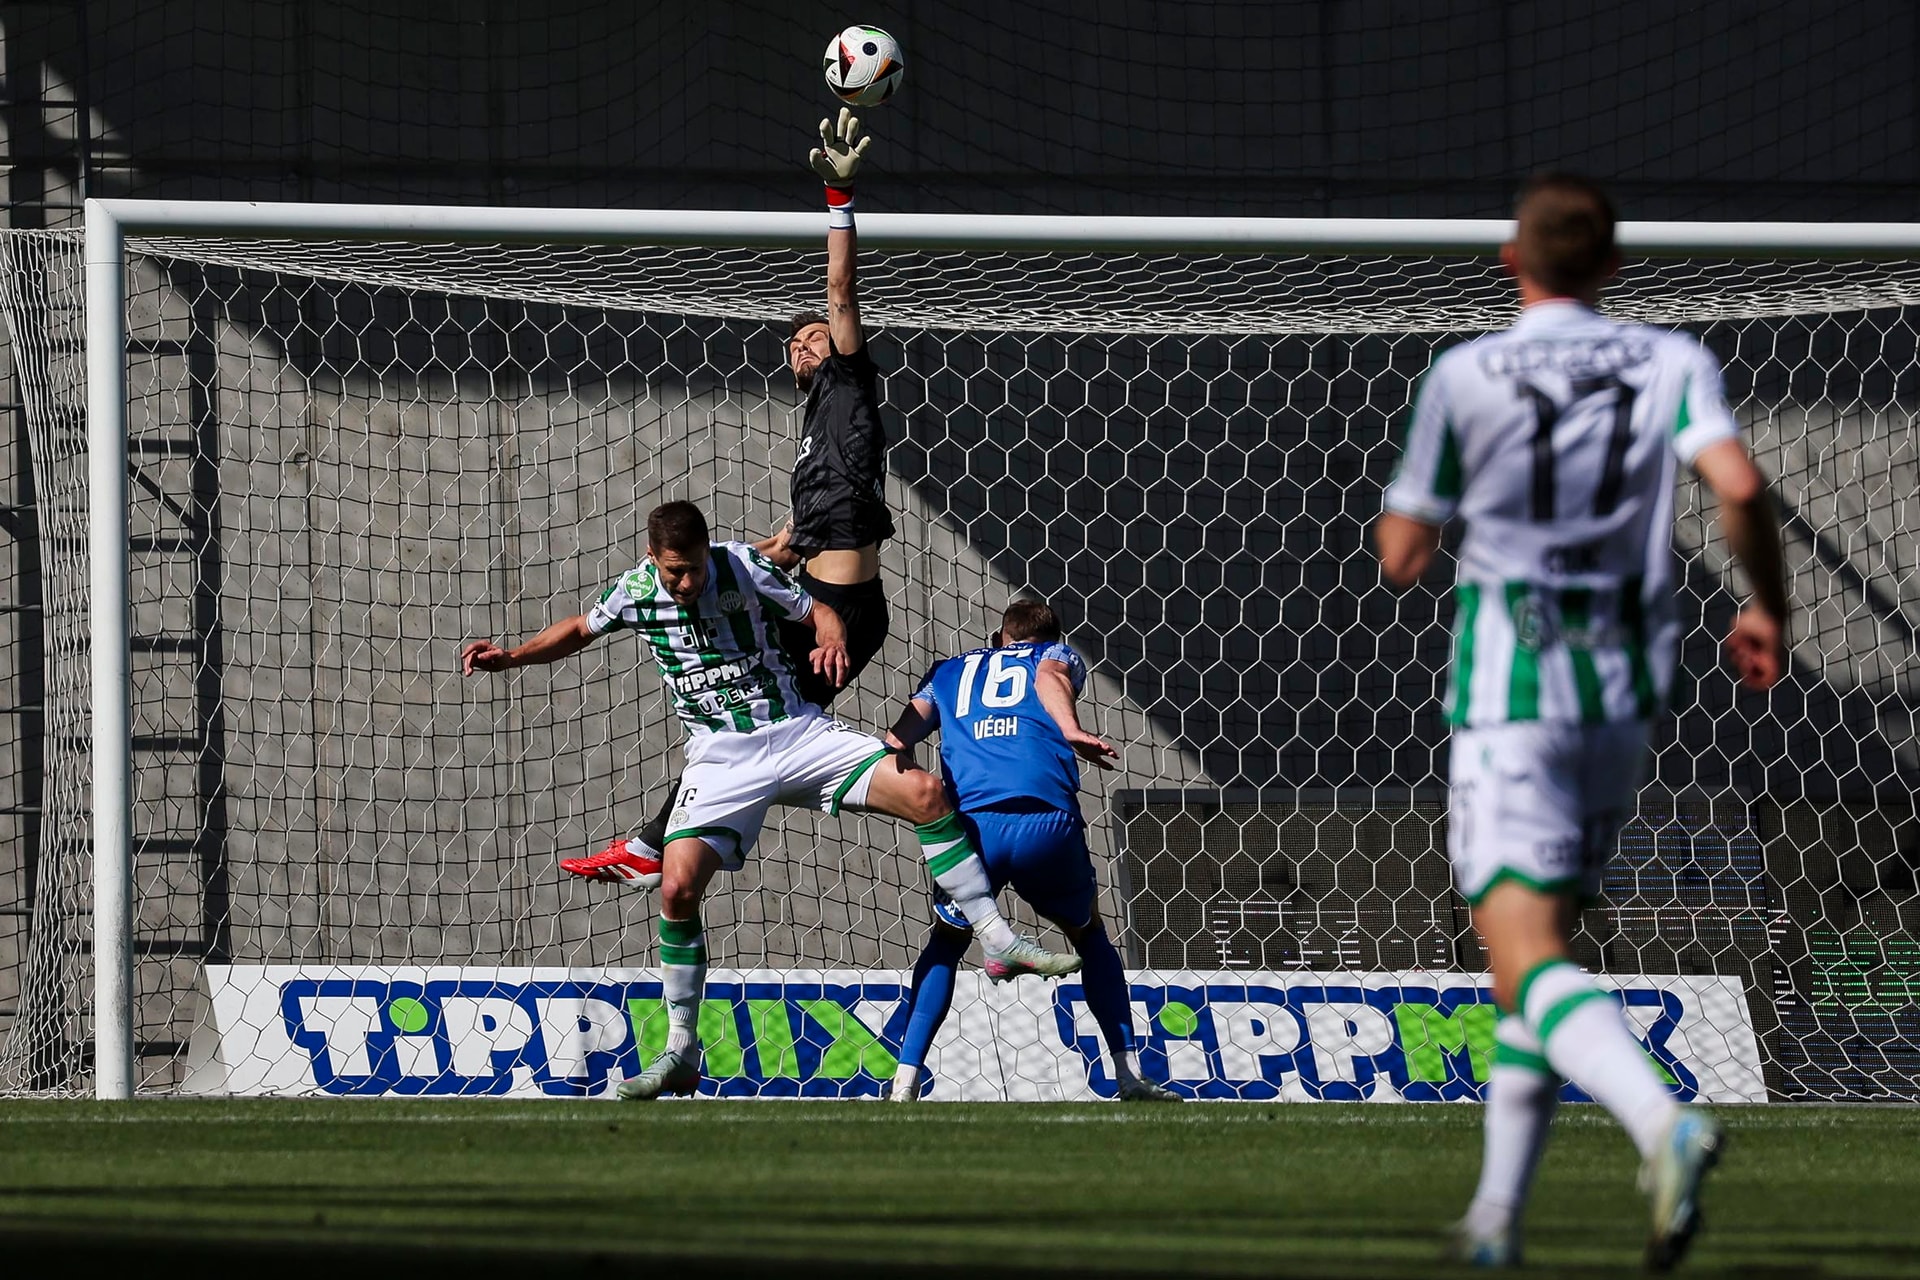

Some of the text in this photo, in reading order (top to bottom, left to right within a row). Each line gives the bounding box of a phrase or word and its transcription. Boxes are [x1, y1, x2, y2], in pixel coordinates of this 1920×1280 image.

[1512, 374, 1637, 521] 17
[956, 649, 1034, 718] 16
[973, 714, 1019, 741] VÉGH
